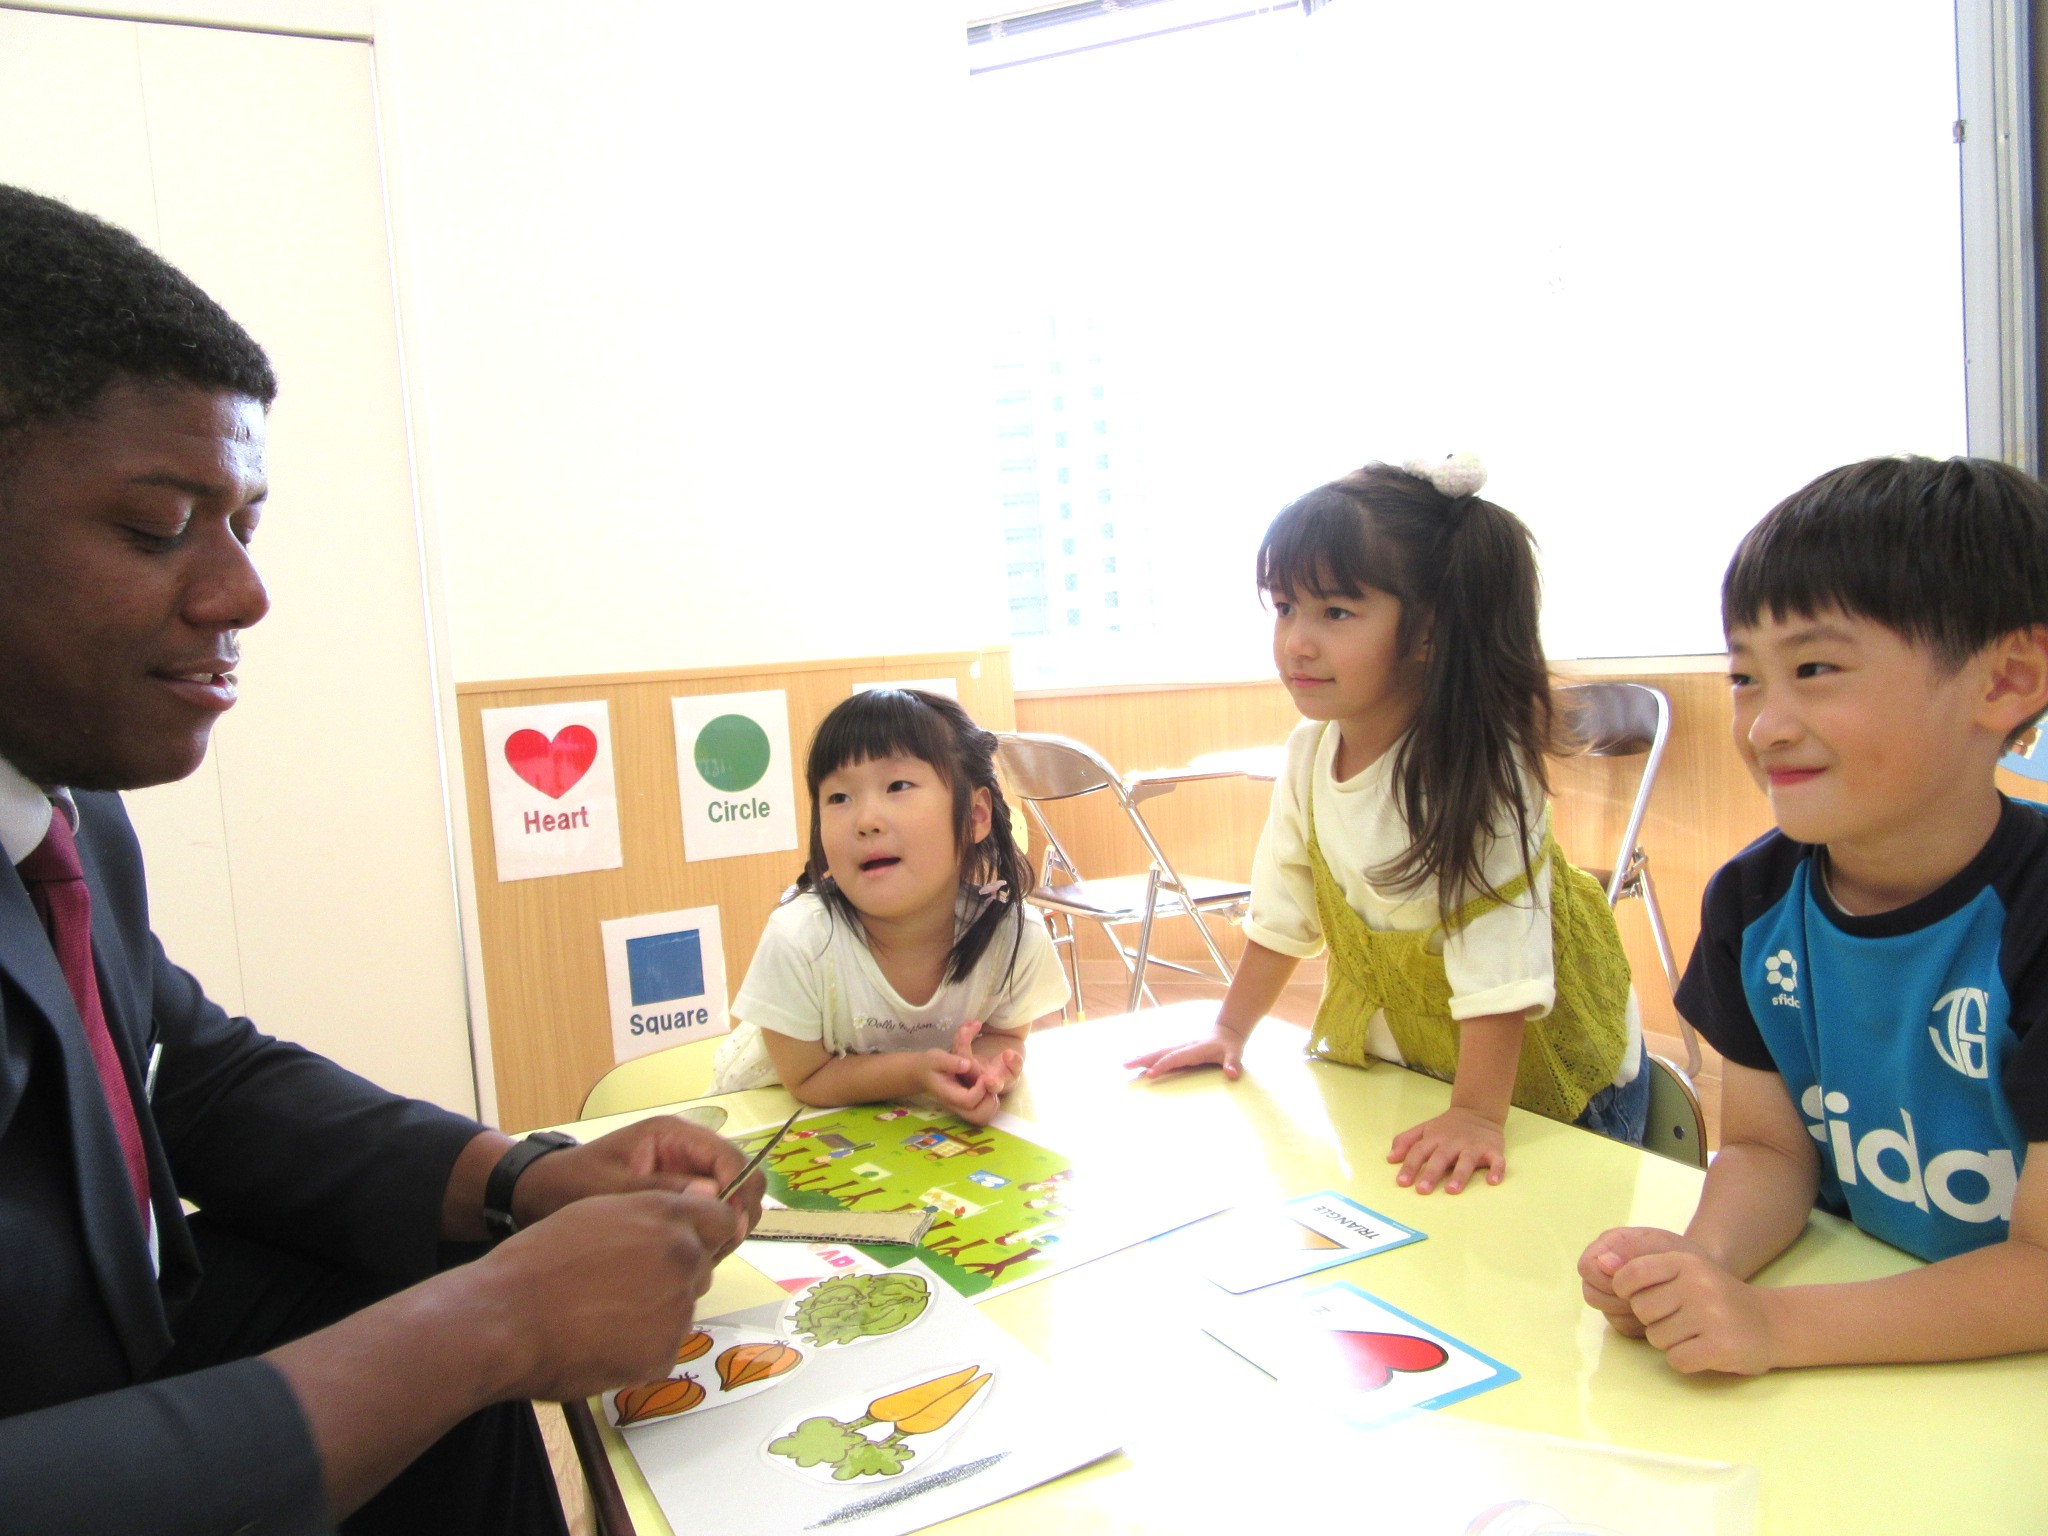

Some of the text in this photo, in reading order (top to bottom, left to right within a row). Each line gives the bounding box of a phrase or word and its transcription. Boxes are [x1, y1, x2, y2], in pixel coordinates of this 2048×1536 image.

[523, 806, 589, 834] Heart
[708, 797, 770, 823] Circle
[630, 1008, 708, 1036] Square
[1313, 1205, 1380, 1240] TRIANGLE
